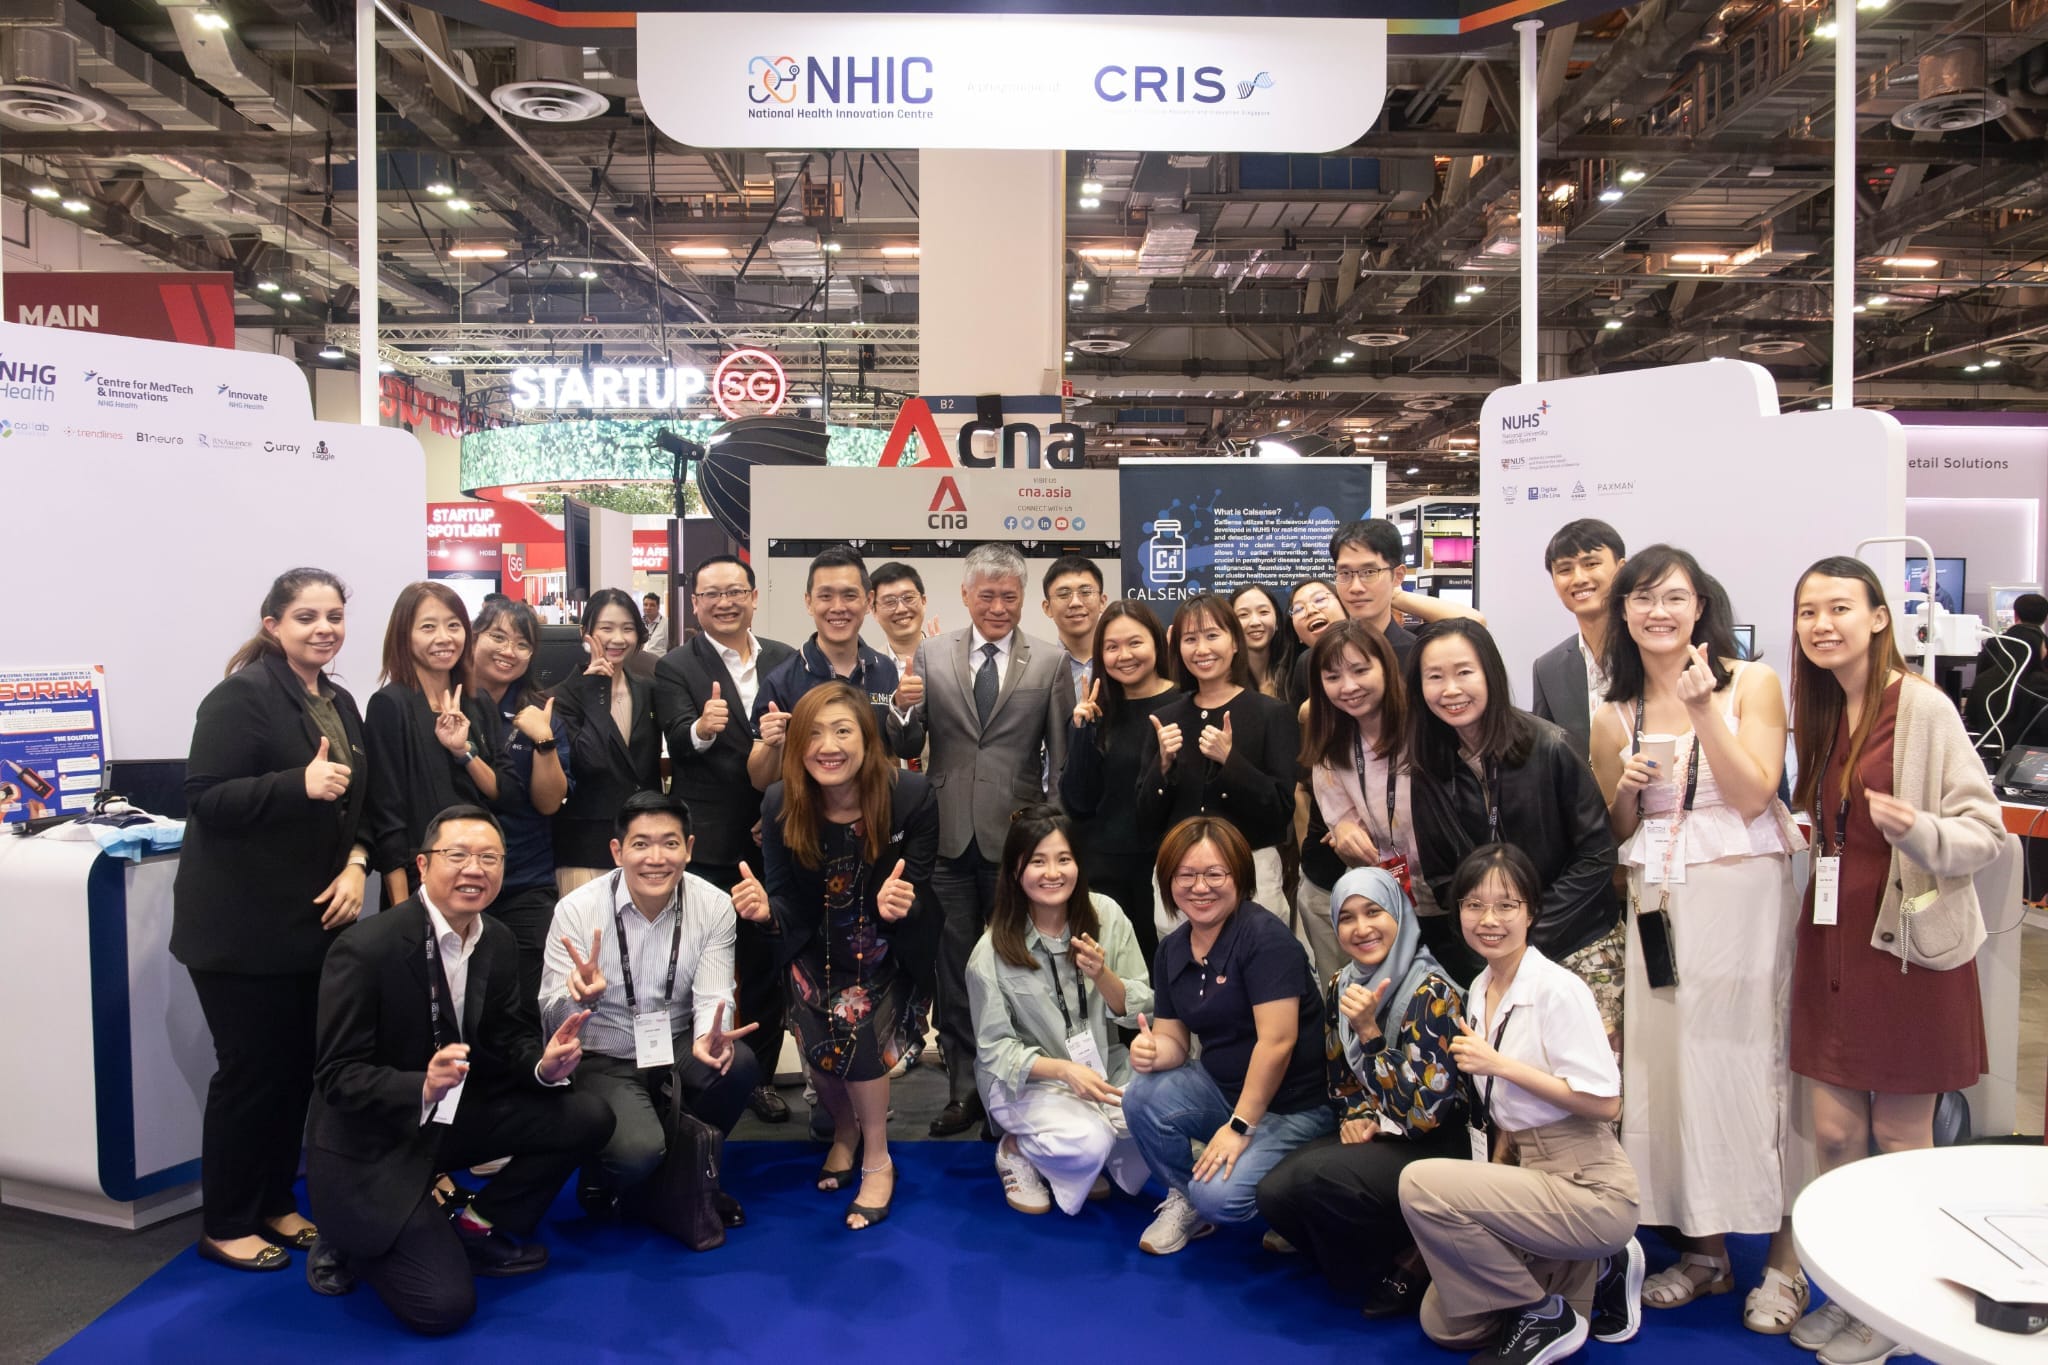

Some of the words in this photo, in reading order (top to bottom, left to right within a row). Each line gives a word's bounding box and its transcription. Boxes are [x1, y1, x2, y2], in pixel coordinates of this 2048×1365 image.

[807, 56, 933, 104] NHIC
[1094, 65, 1226, 103] CRIS
[748, 108, 794, 119] National
[797, 108, 833, 119] Health
[836, 108, 894, 119] Innovation
[897, 108, 934, 119] Centre
[19, 304, 99, 328] MAIN
[0, 361, 57, 385] NHG
[0, 383, 55, 402] Health
[97, 376, 131, 390] Centre
[133, 379, 147, 390] for
[150, 381, 194, 395] MedTech
[511, 366, 705, 409] STARTUP
[722, 370, 776, 402] SG
[97, 387, 107, 396] &
[108, 388, 169, 402] Innovations
[228, 390, 268, 402] Innovate
[940, 399, 954, 409] B2
[1502, 413, 1540, 430] NUHS
[77, 429, 124, 440] trendlines
[956, 419, 1086, 470] cna
[1511, 457, 1525, 465] NUS
[1908, 457, 1939, 469] etail
[1943, 457, 2009, 469] Solutions
[1018, 486, 1072, 498] cna.asia
[1597, 482, 1634, 492] PAXMAN
[433, 508, 495, 522] STARTUP
[1243, 508, 1282, 516] Calsense?
[928, 513, 968, 530] cna
[427, 523, 501, 537] SPOTLIGHT
[510, 556, 523, 571] SG
[0, 680, 93, 701] SORAM
[67, 734, 98, 742] SOLUTION
